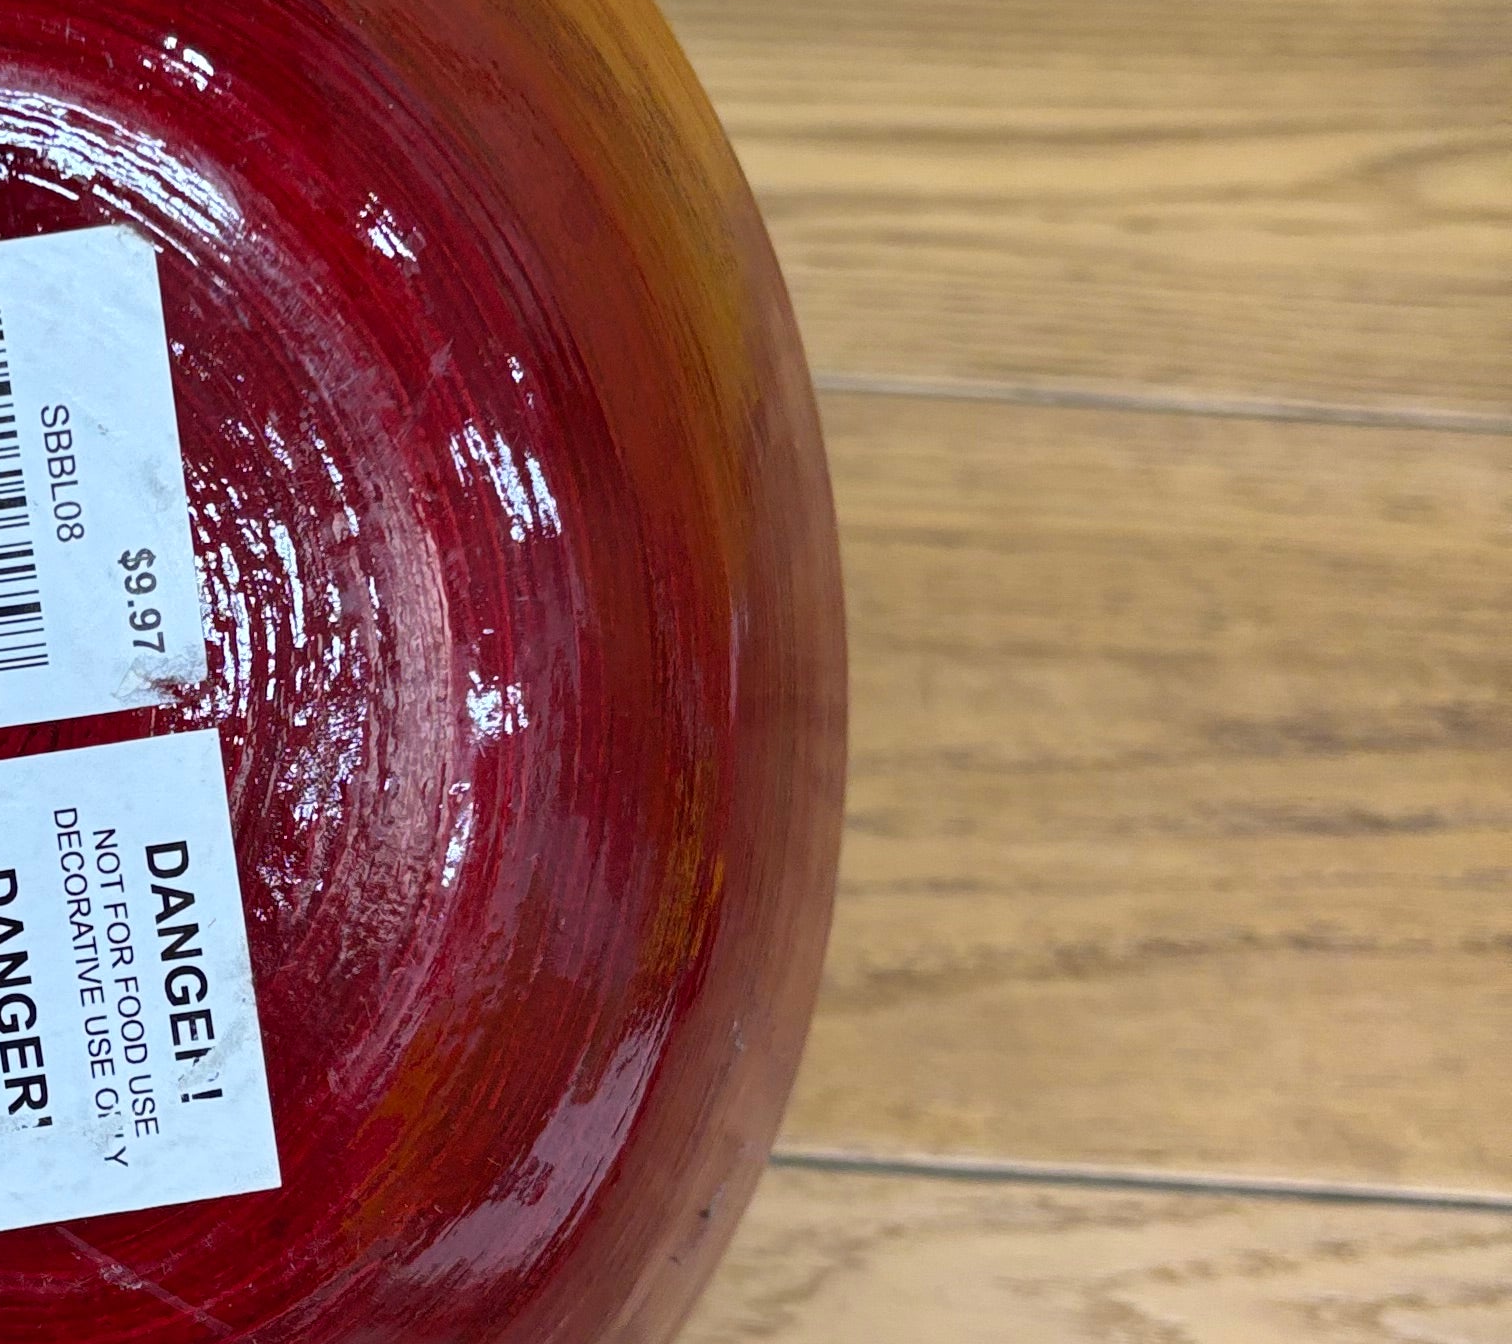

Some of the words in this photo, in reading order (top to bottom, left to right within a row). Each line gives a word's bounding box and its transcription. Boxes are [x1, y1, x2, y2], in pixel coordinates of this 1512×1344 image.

[39, 403, 85, 544] SBBL08
[115, 547, 166, 654] $9.97
[90, 827, 125, 894] NOT
[52, 806, 105, 1008] DECORATIVE
[101, 900, 135, 970] FOR
[82, 1014, 116, 1080] USE
[112, 975, 148, 1065] FOOD
[93, 1086, 129, 1168] OY
[126, 1073, 160, 1139] USE
